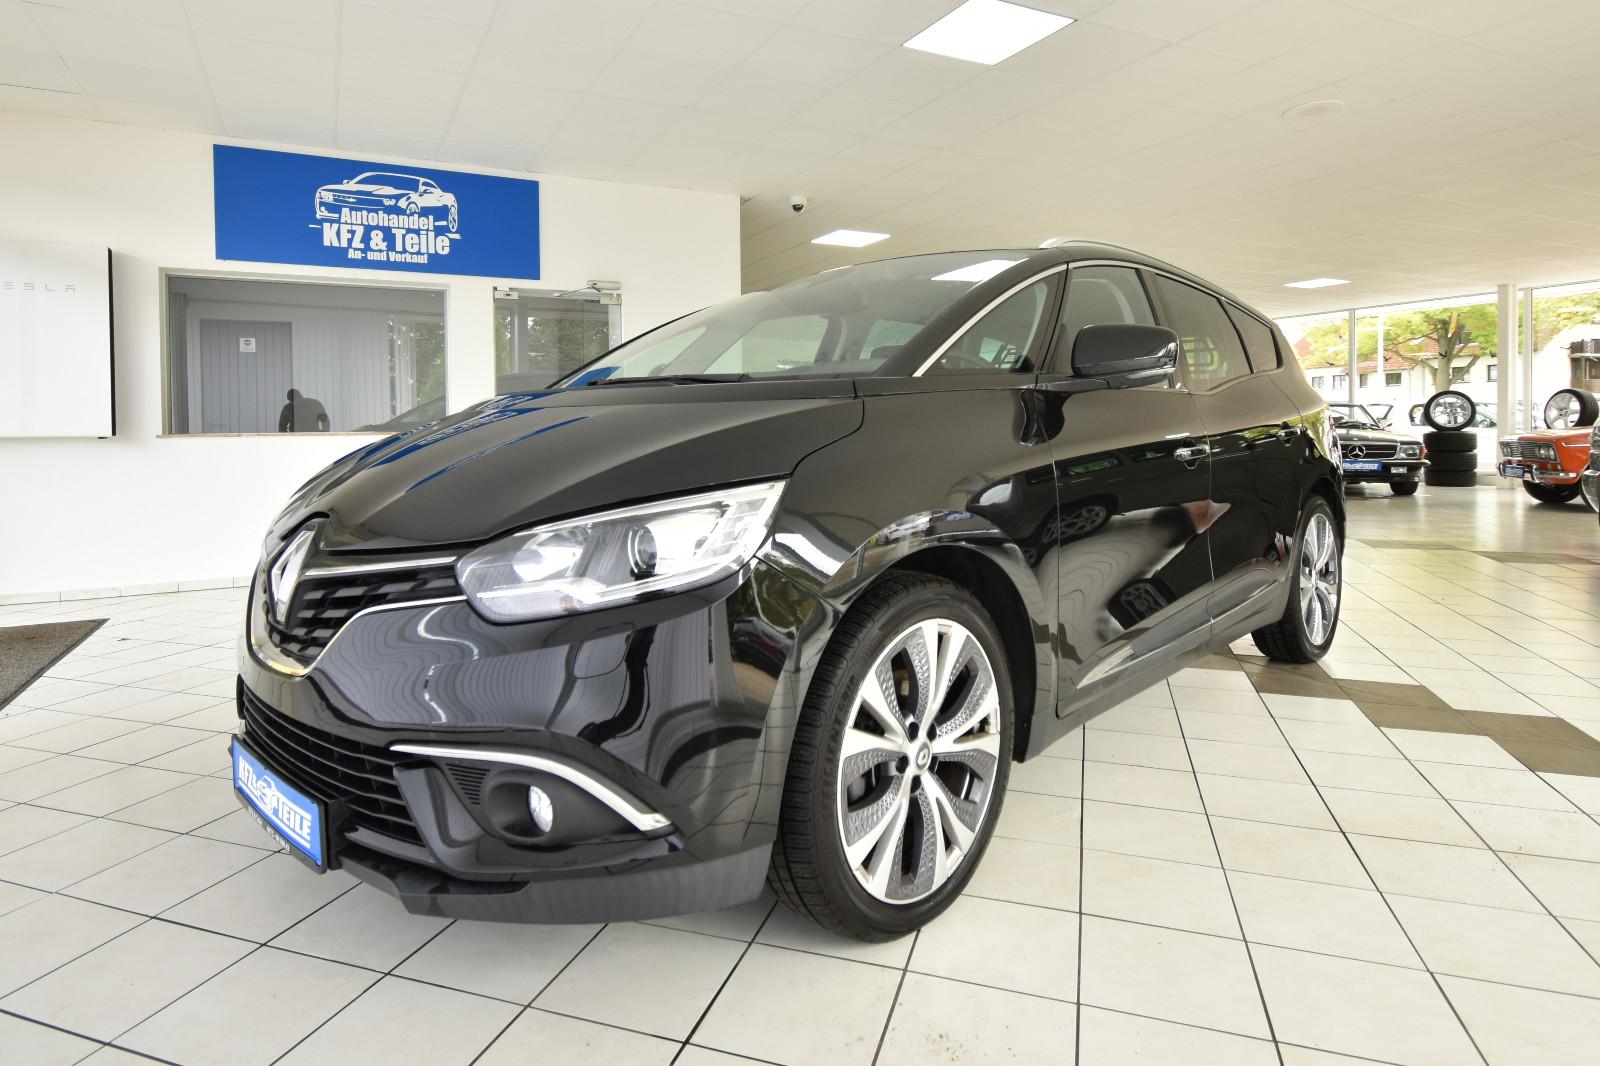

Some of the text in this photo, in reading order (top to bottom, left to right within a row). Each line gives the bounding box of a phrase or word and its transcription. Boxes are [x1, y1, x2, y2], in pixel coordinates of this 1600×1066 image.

[340, 207, 434, 230] Autohandel
[323, 222, 450, 255] KFZ & Teile
[347, 248, 428, 263] An- und Verkauf
[277, 795, 312, 841] TEILE
